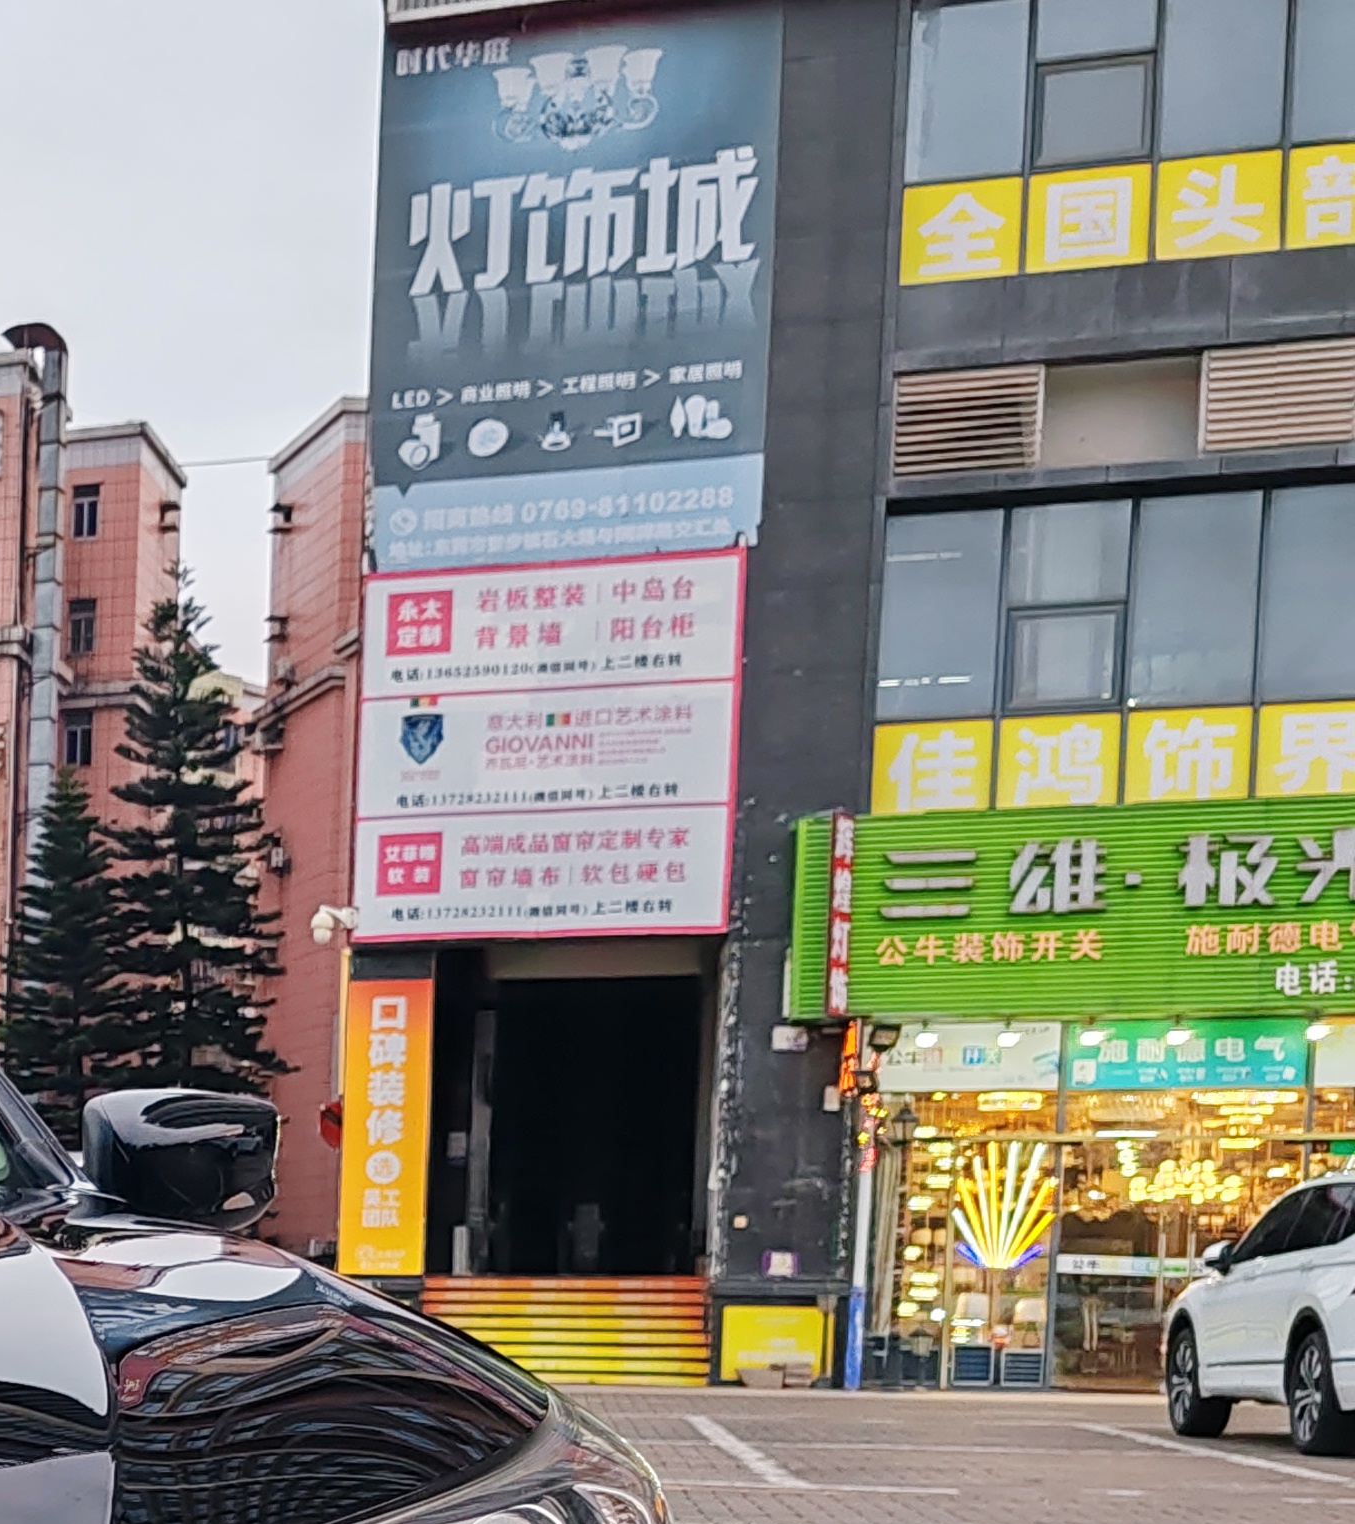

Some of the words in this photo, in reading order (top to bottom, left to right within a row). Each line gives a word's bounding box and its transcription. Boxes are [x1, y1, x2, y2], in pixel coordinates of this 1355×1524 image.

[409, 145, 758, 297] 灯饰城
[391, 389, 431, 411] LED
[611, 575, 695, 604] 中岛台
[475, 621, 563, 651] 背景墙
[610, 612, 696, 643] 阳台柜
[484, 731, 594, 754] GIOVANNI
[887, 713, 1355, 811] 佳鸿饰界
[875, 928, 1106, 967] 公牛装饰开关
[366, 996, 408, 1147] 口碑装修
